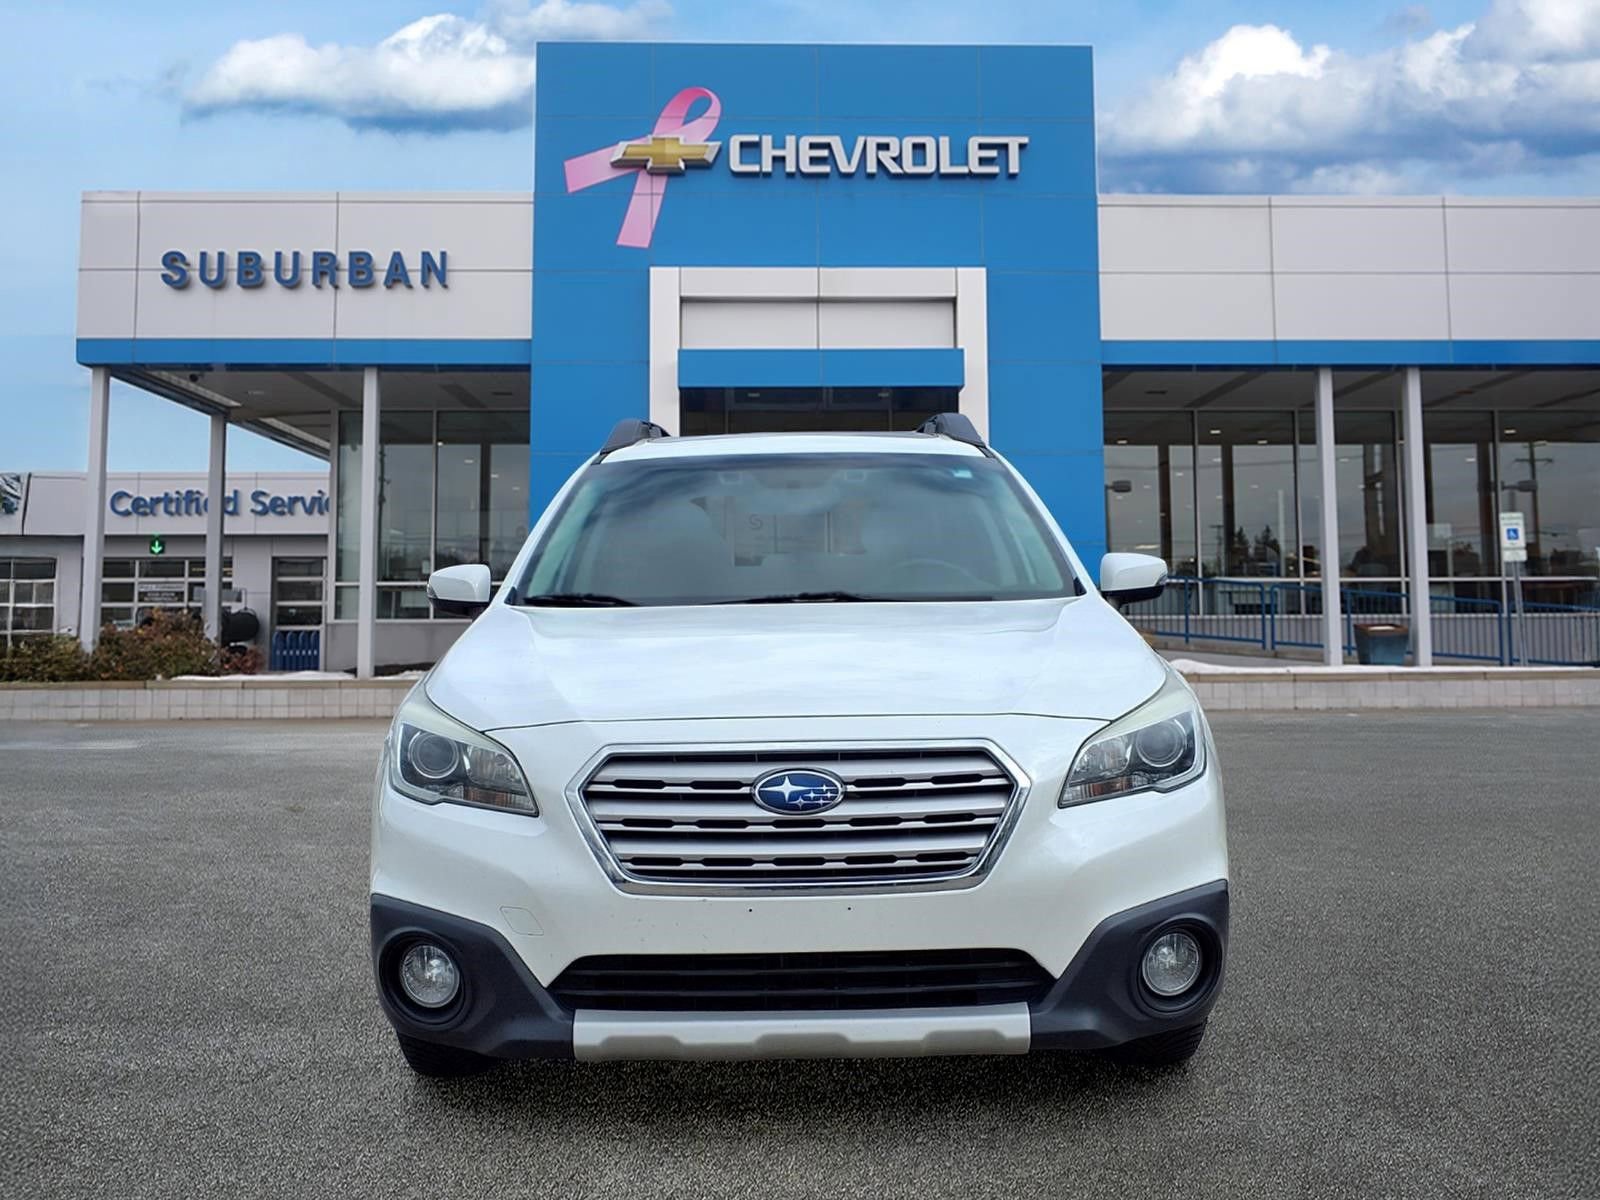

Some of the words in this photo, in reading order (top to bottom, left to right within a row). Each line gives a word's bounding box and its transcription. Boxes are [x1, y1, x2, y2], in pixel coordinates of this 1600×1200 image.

[729, 134, 1029, 177] CHEVROLET
[161, 250, 448, 289] SUBURBAN
[110, 489, 240, 517] Certifid
